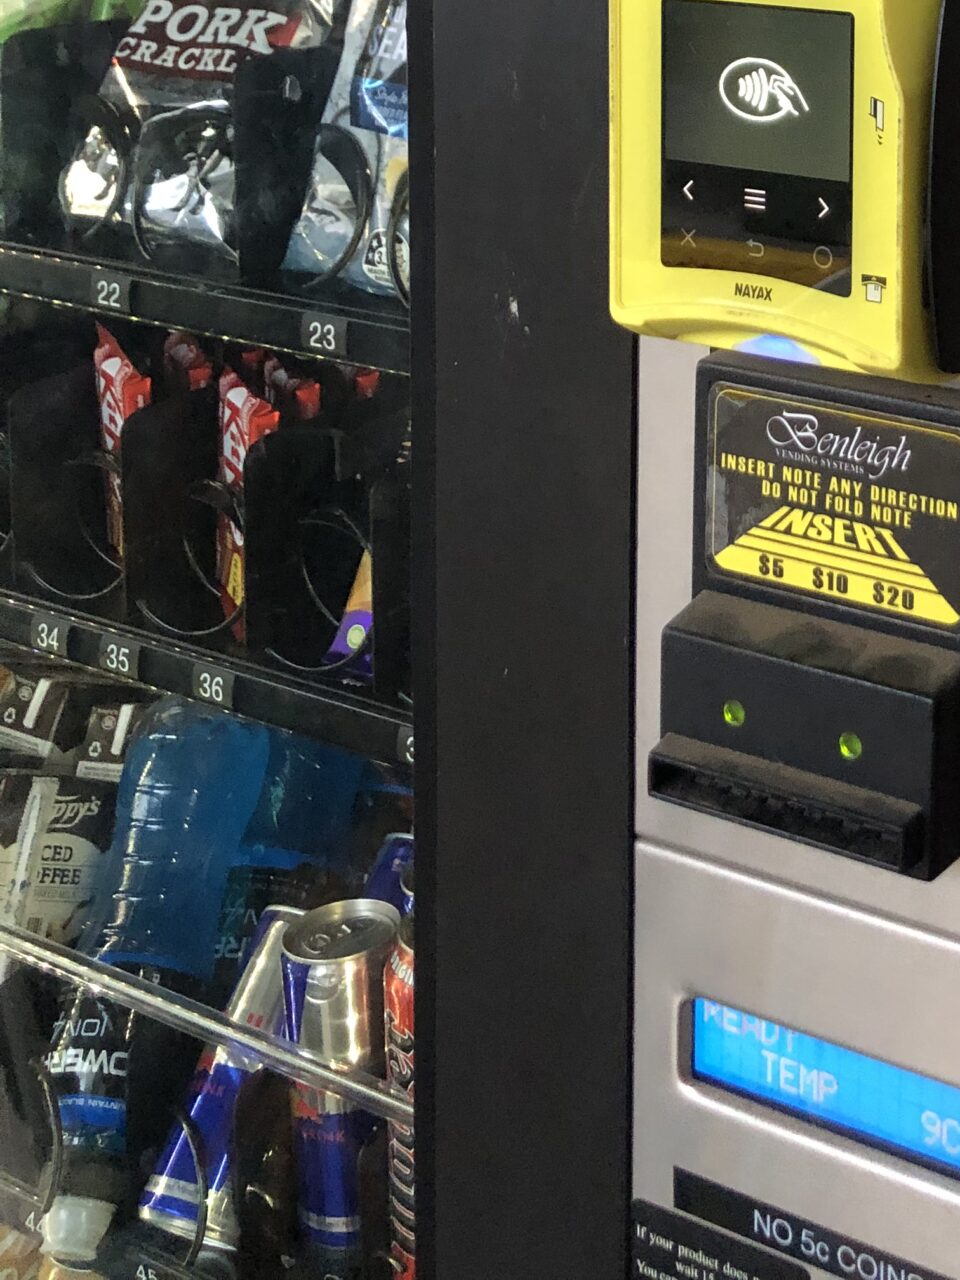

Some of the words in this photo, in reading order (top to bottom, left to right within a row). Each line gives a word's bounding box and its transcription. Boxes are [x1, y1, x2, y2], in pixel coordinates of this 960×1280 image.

[114, 36, 243, 73] CRACKL
[97, 279, 121, 308] 22
[735, 283, 773, 301] NAYAX
[309, 322, 337, 350] 23
[766, 409, 912, 480] Benleigh
[775, 447, 818, 464] VENDING
[820, 457, 865, 474] SYSTEMS
[721, 453, 776, 479] INSERT
[783, 466, 821, 489] NOTE
[829, 476, 862, 497] ANY
[871, 485, 958, 519] DIRECTION
[762, 480, 780, 498] DO
[788, 486, 818, 506] NOT
[825, 494, 863, 517] FOLD
[871, 506, 912, 529] NOTE
[758, 505, 911, 563] INSERT
[758, 553, 784, 579] $5
[812, 566, 849, 594] $10
[872, 581, 915, 611] $20
[37, 624, 59, 649] 34
[106, 646, 129, 672] 35
[199, 675, 224, 701] 36
[41, 845, 73, 862] CED
[761, 1049, 838, 1103] TEMP
[636, 1223, 647, 1239] If
[649, 1232, 674, 1251] your
[678, 1245, 719, 1271] product
[753, 1208, 792, 1247] NO
[800, 1228, 829, 1263] 5c
[837, 1245, 924, 1280] COIN
[636, 1258, 657, 1278] You
[675, 1261, 699, 1278] wait
